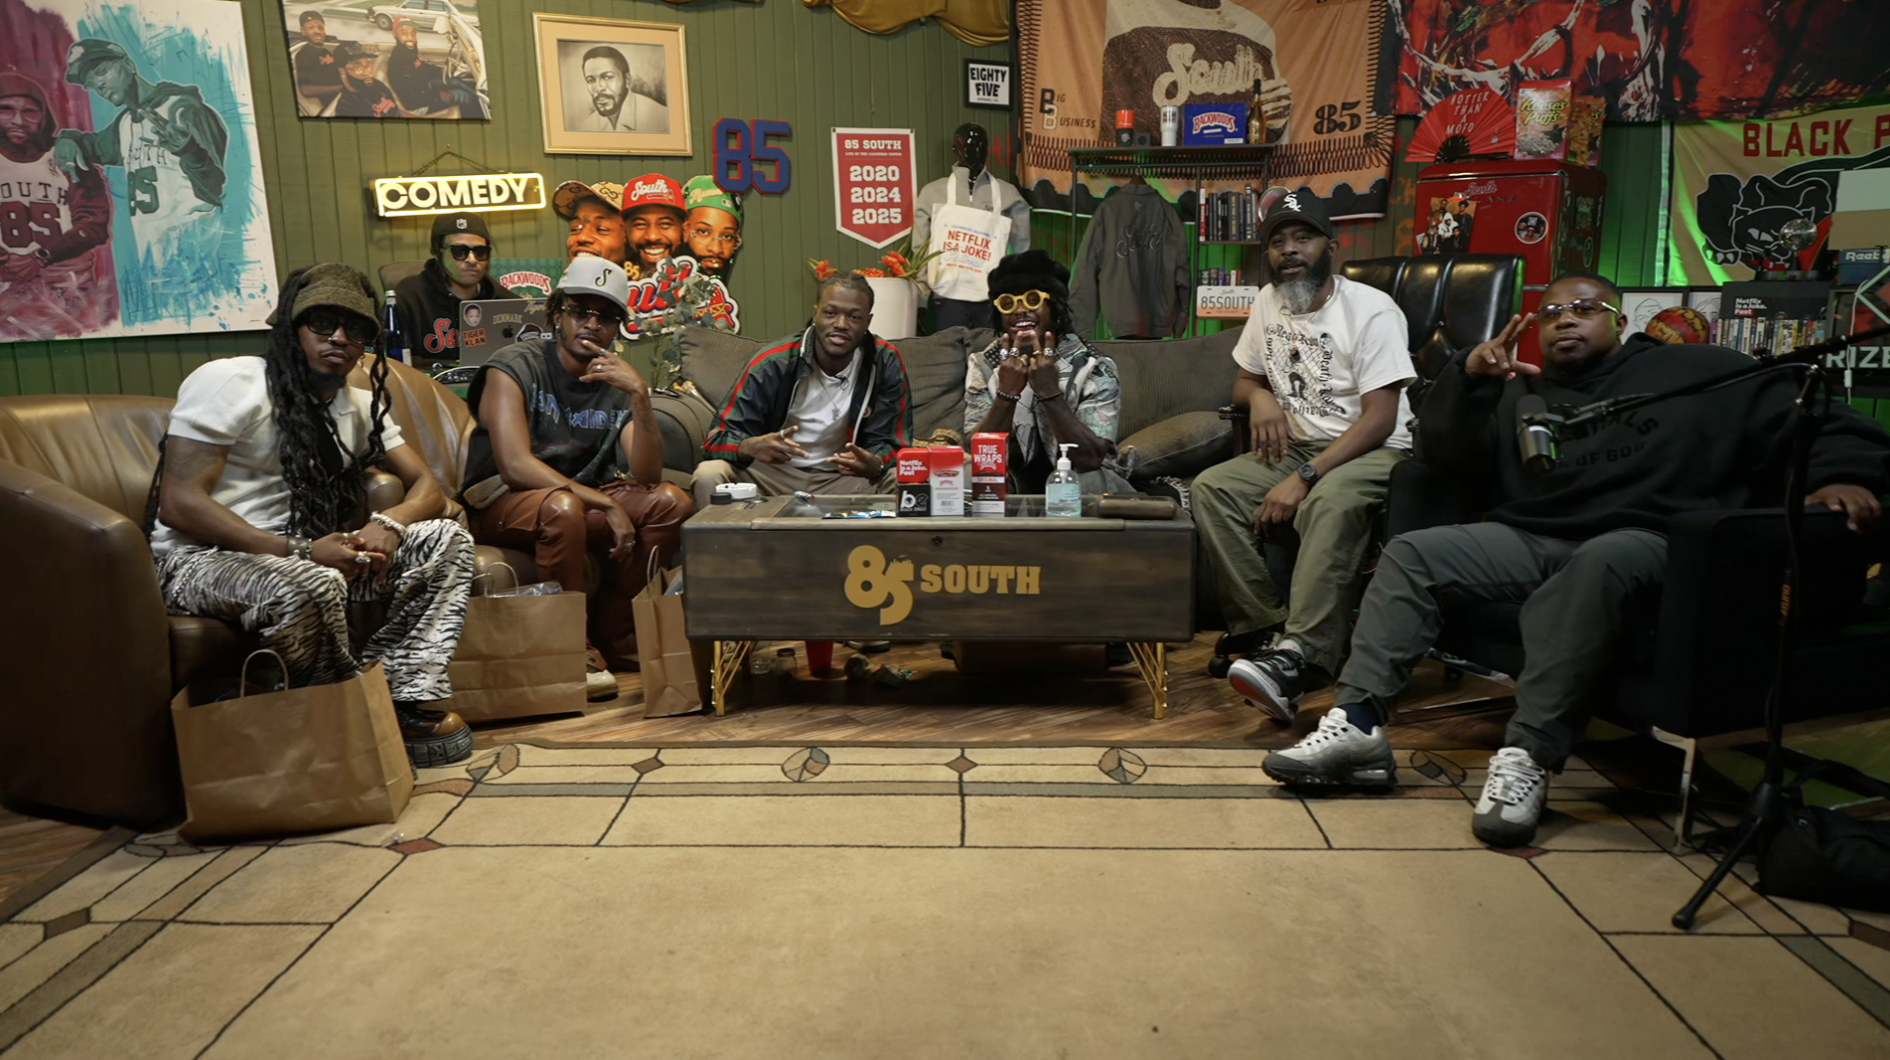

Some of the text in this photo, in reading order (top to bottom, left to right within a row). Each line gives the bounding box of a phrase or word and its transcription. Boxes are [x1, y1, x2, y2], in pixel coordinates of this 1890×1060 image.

[970, 67, 1007, 82] EIGHTY
[1152, 43, 1264, 107] South
[975, 82, 1000, 97] FIVE
[1313, 99, 1362, 135] 85
[1454, 103, 1483, 116] THAN
[1193, 112, 1236, 132] BACKWOODS
[1460, 113, 1468, 124] A
[1523, 111, 1560, 126] Puffs
[1445, 123, 1475, 135] MOFO
[844, 139, 902, 150] 85 SOUTH
[1743, 118, 1854, 157] BLACK
[712, 117, 791, 194] 85
[849, 165, 900, 182] 2020
[380, 177, 529, 210] COMEDY
[630, 179, 669, 201] South
[850, 187, 902, 203] 2024
[852, 208, 902, 224] 2025
[0, 201, 63, 248] 85
[947, 230, 992, 249] NETFLIX
[961, 245, 992, 261] JOKE!
[624, 260, 640, 281] 85
[501, 271, 552, 294] BACKWOODS
[1201, 296, 1255, 309] 85SOUTH
[463, 329, 485, 339] TIGER
[465, 337, 487, 346] KLAN
[977, 444, 998, 454] TRUE
[973, 454, 1003, 463] WRAPS
[844, 544, 1041, 626] 85 SOUTH
